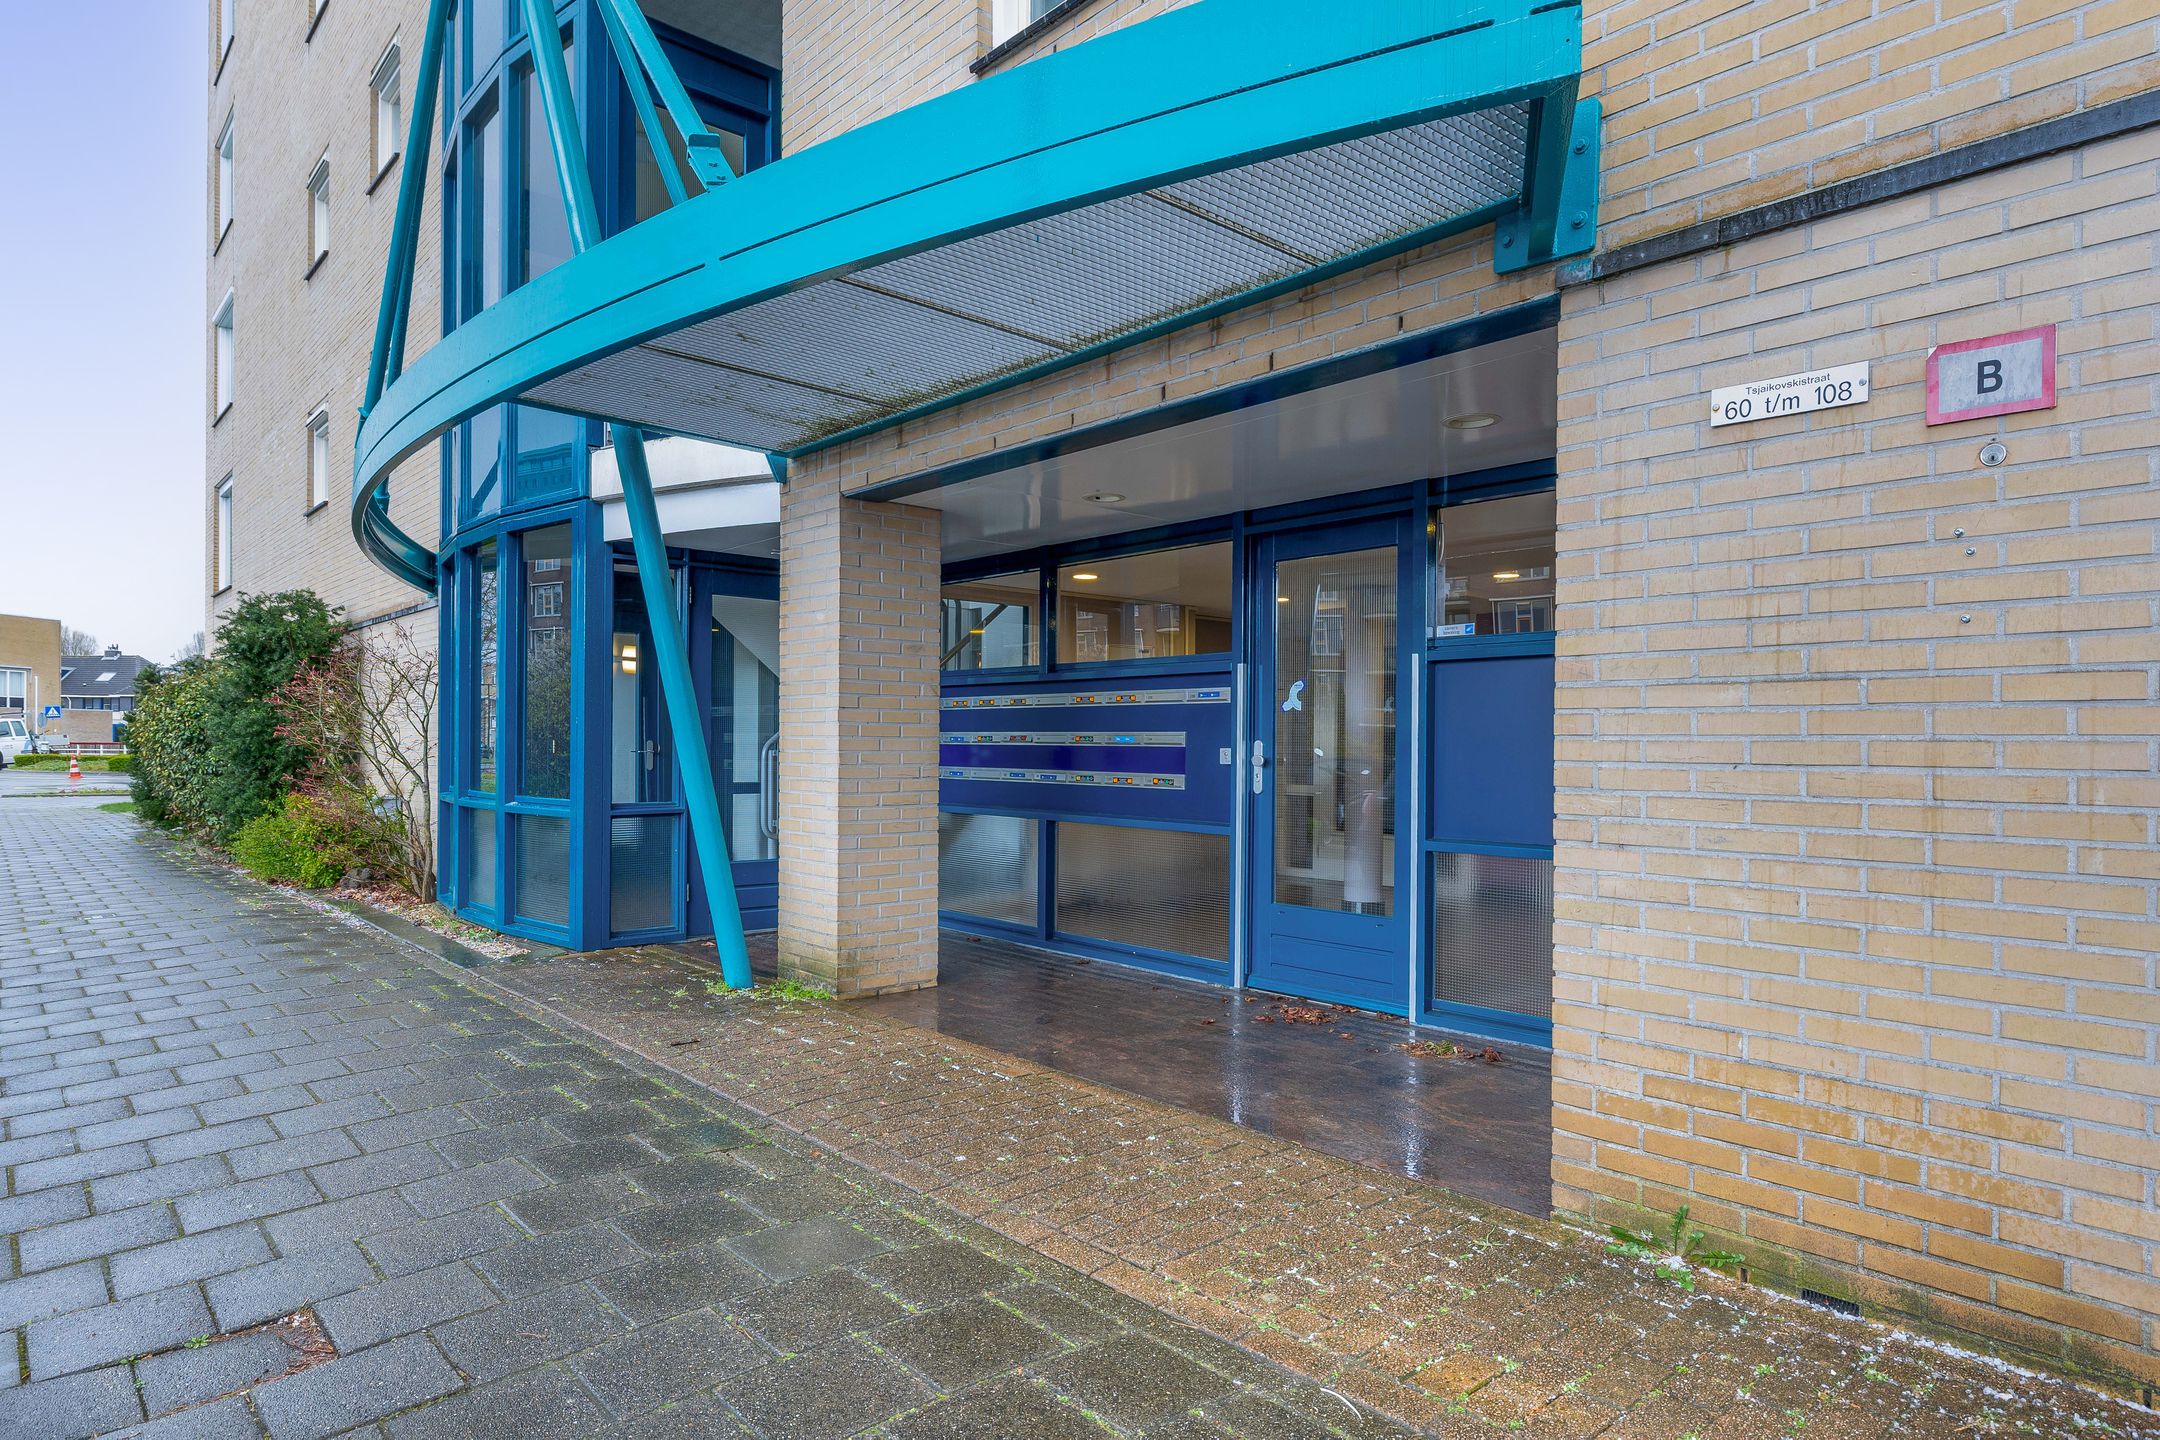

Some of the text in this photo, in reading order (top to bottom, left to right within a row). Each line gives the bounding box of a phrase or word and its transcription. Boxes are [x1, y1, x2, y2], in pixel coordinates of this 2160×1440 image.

[1745, 373, 1831, 395] Tsjaikovskistraat
[1976, 359, 2004, 395] B
[1725, 381, 1852, 420] 60 t/m 108
